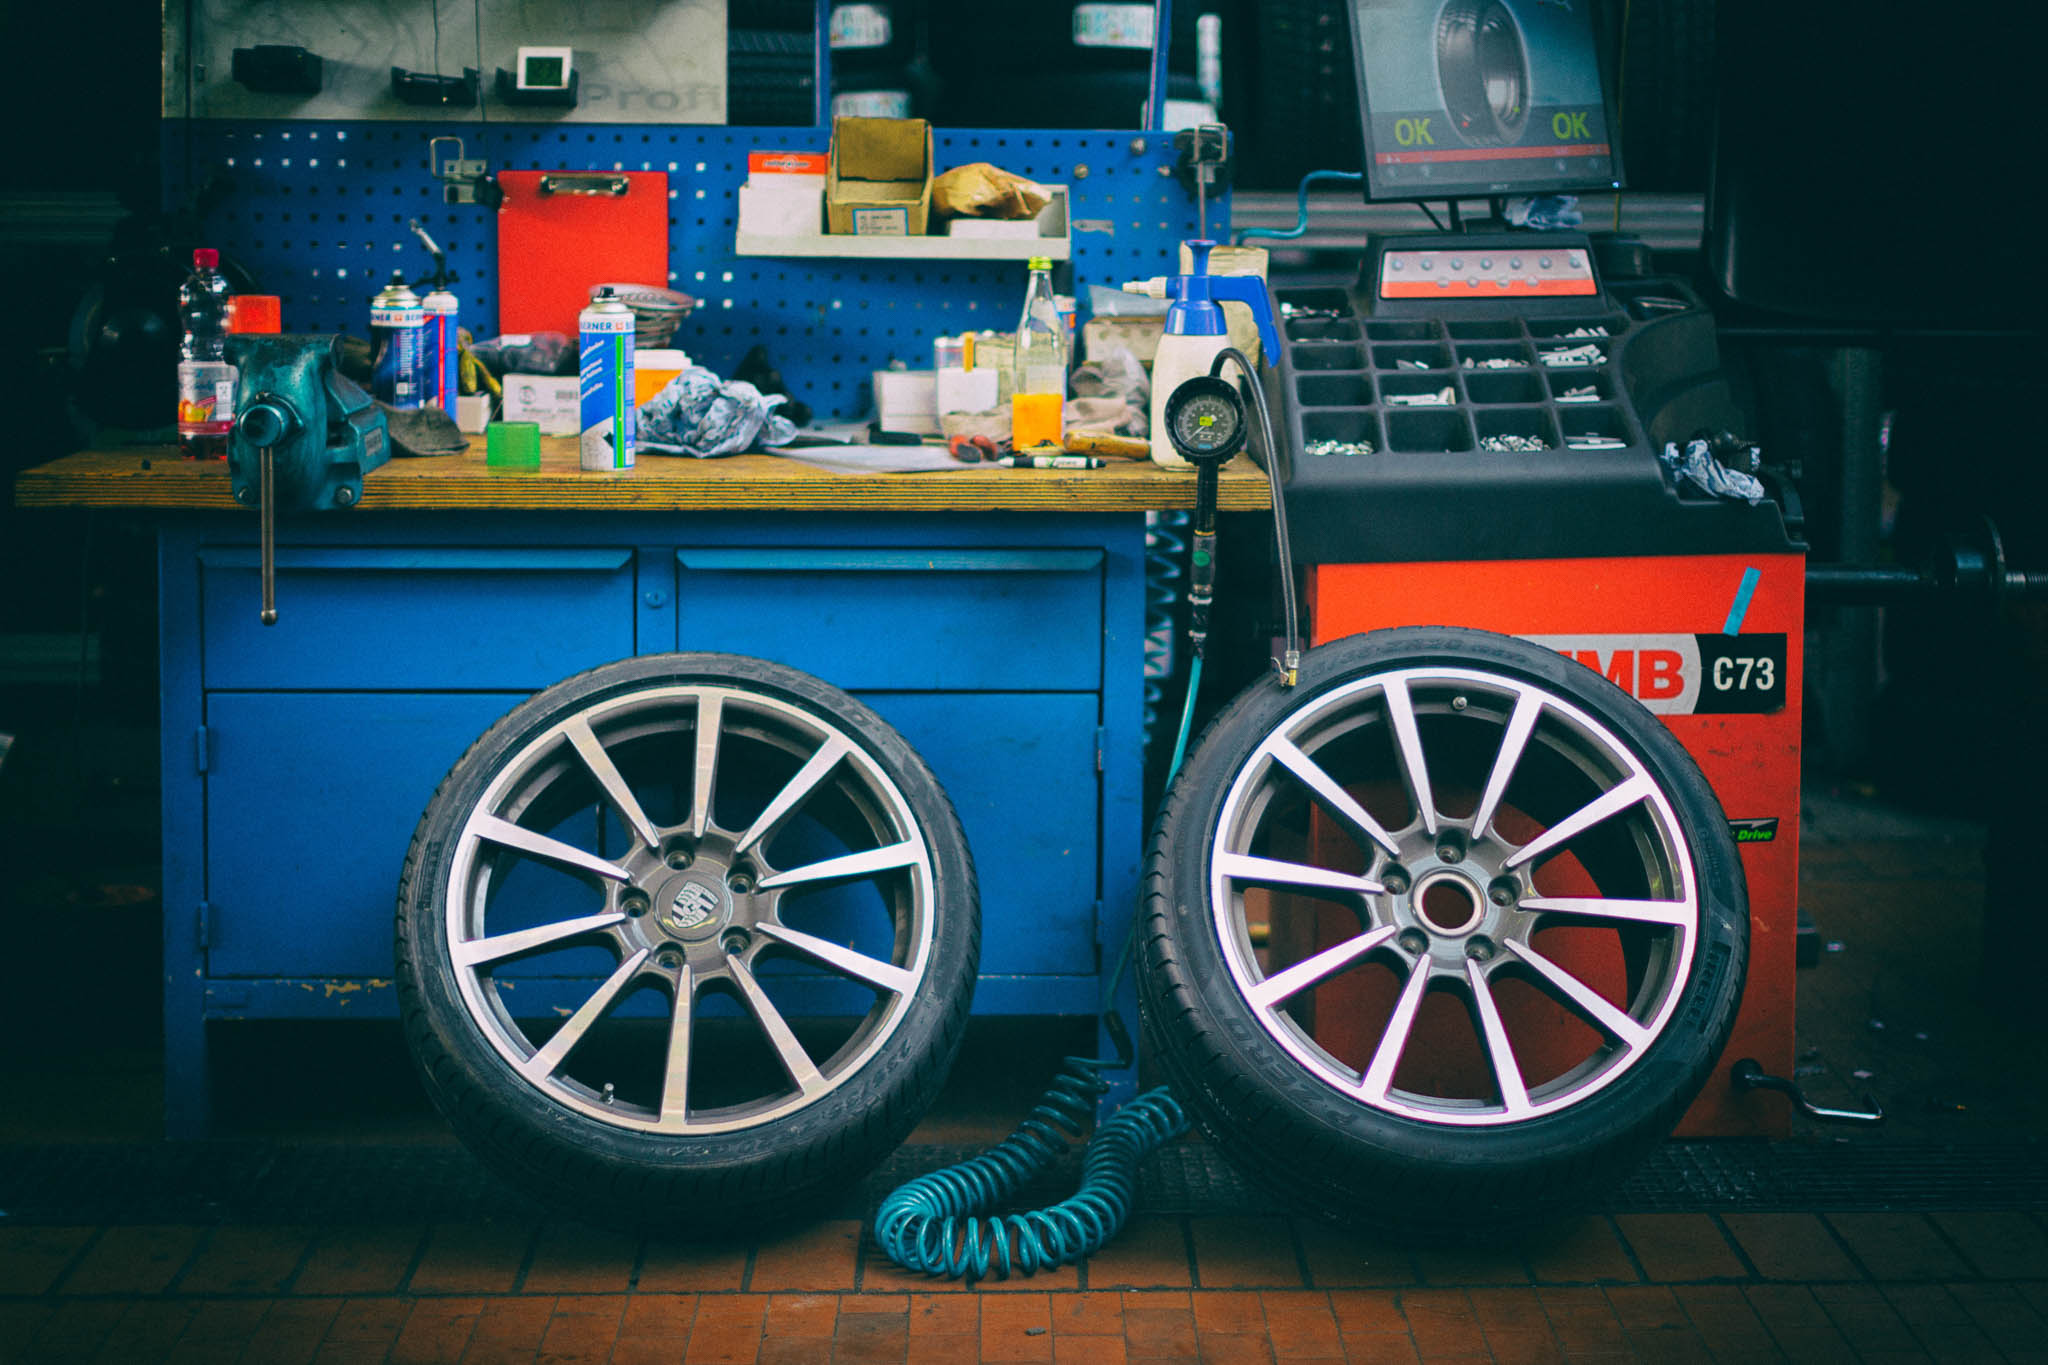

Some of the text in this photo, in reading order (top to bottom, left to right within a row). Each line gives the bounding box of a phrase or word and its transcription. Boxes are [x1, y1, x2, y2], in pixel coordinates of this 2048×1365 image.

[1395, 118, 1434, 146] OK
[1553, 112, 1591, 139] OK
[1557, 650, 1684, 699] MB
[1713, 657, 1775, 691] C73
[1738, 829, 1773, 840] Drive
